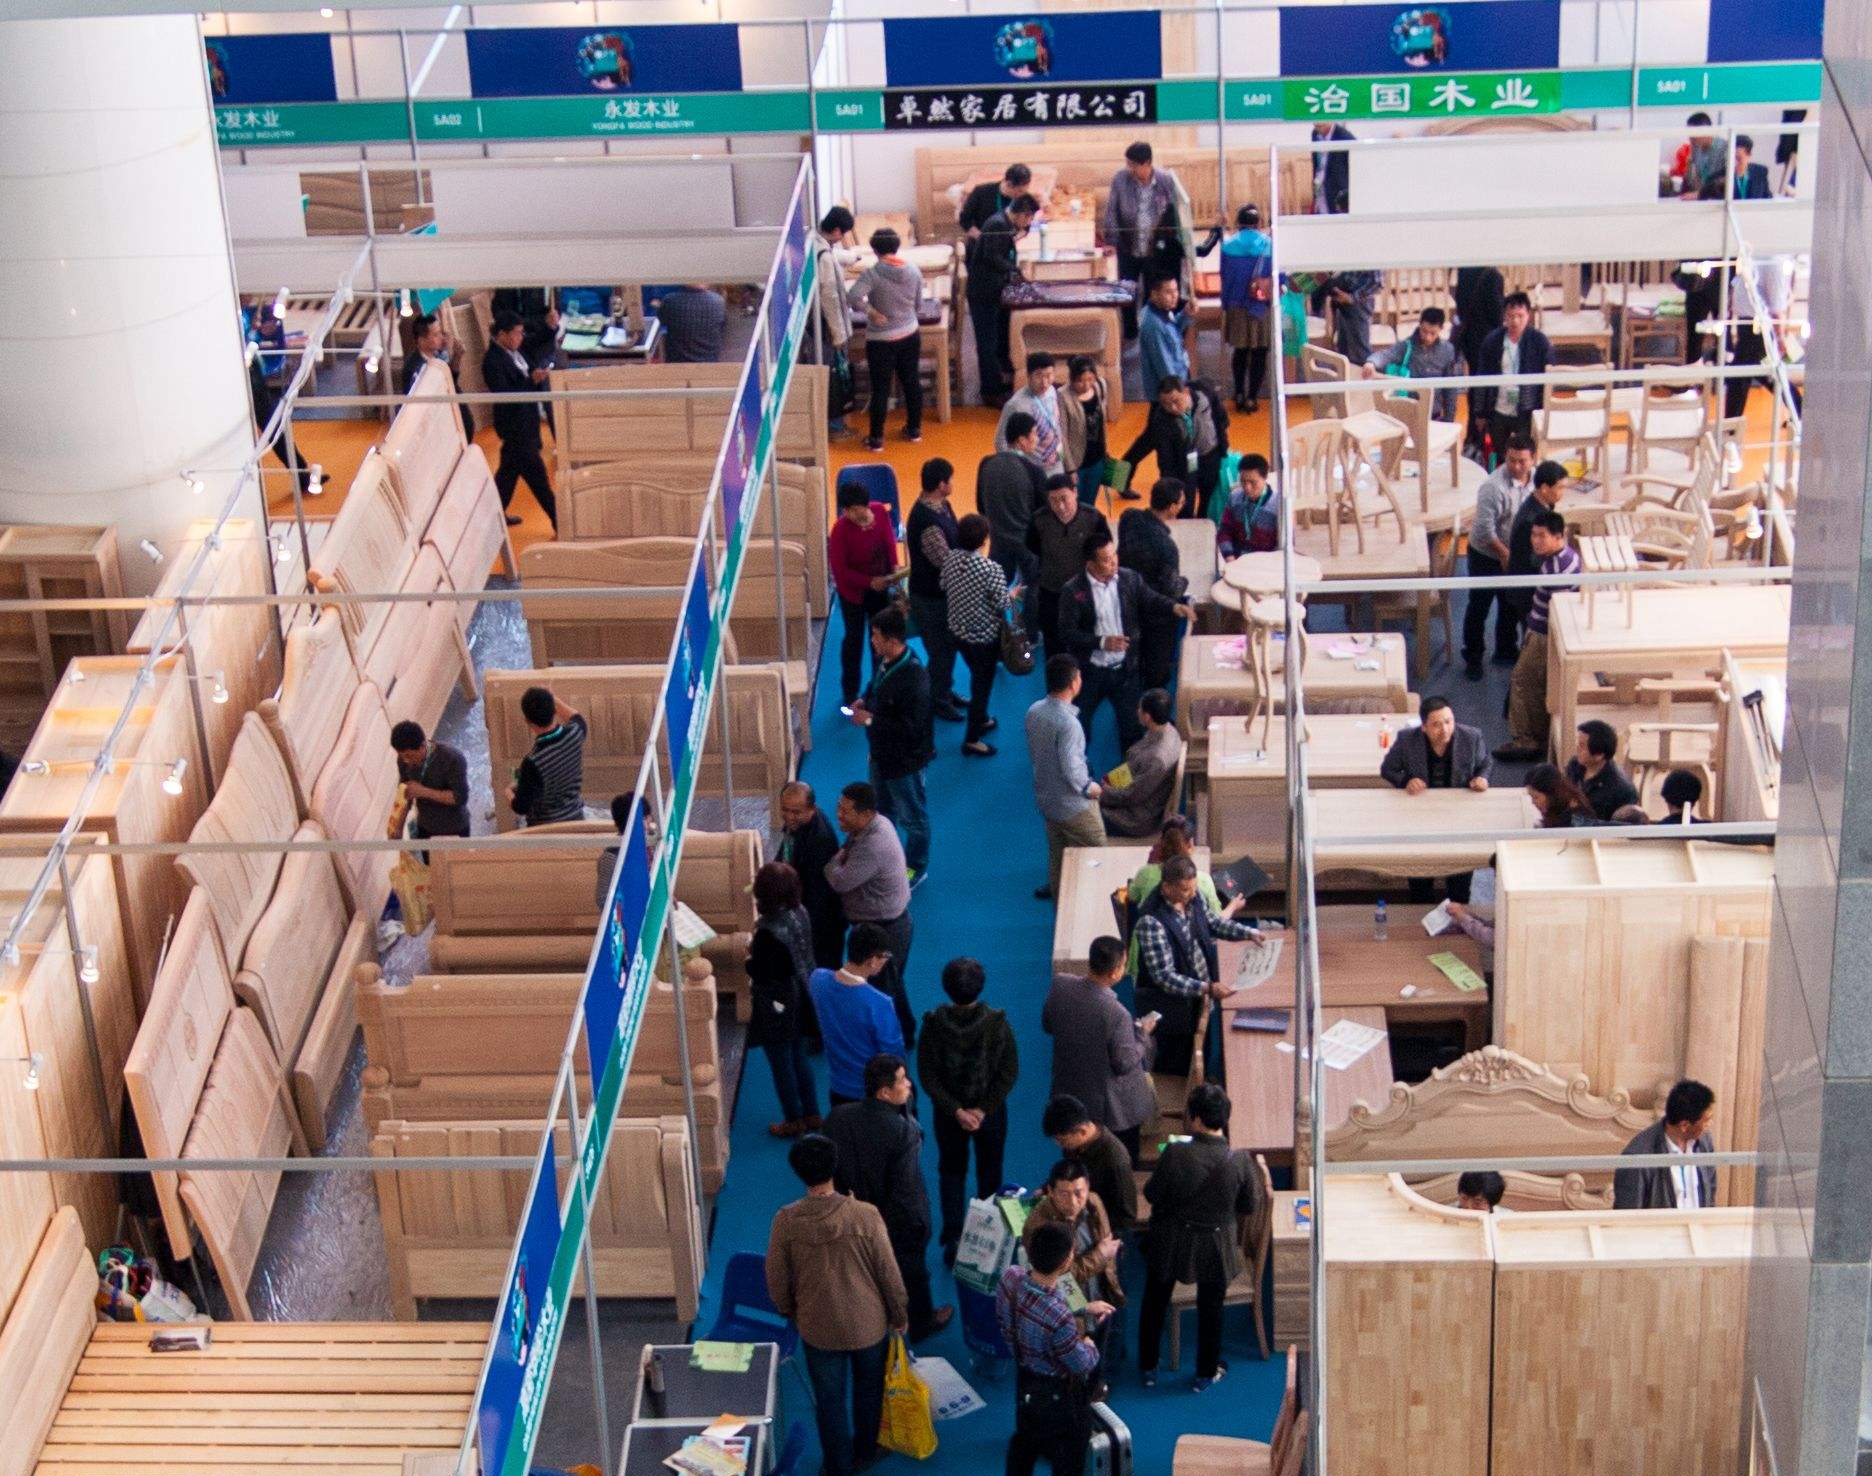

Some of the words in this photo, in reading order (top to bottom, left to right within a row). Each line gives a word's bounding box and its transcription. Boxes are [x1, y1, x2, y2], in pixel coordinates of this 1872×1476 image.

[895, 91, 1148, 124] 卓然家居有限公司
[1304, 78, 1539, 113] 治国木业
